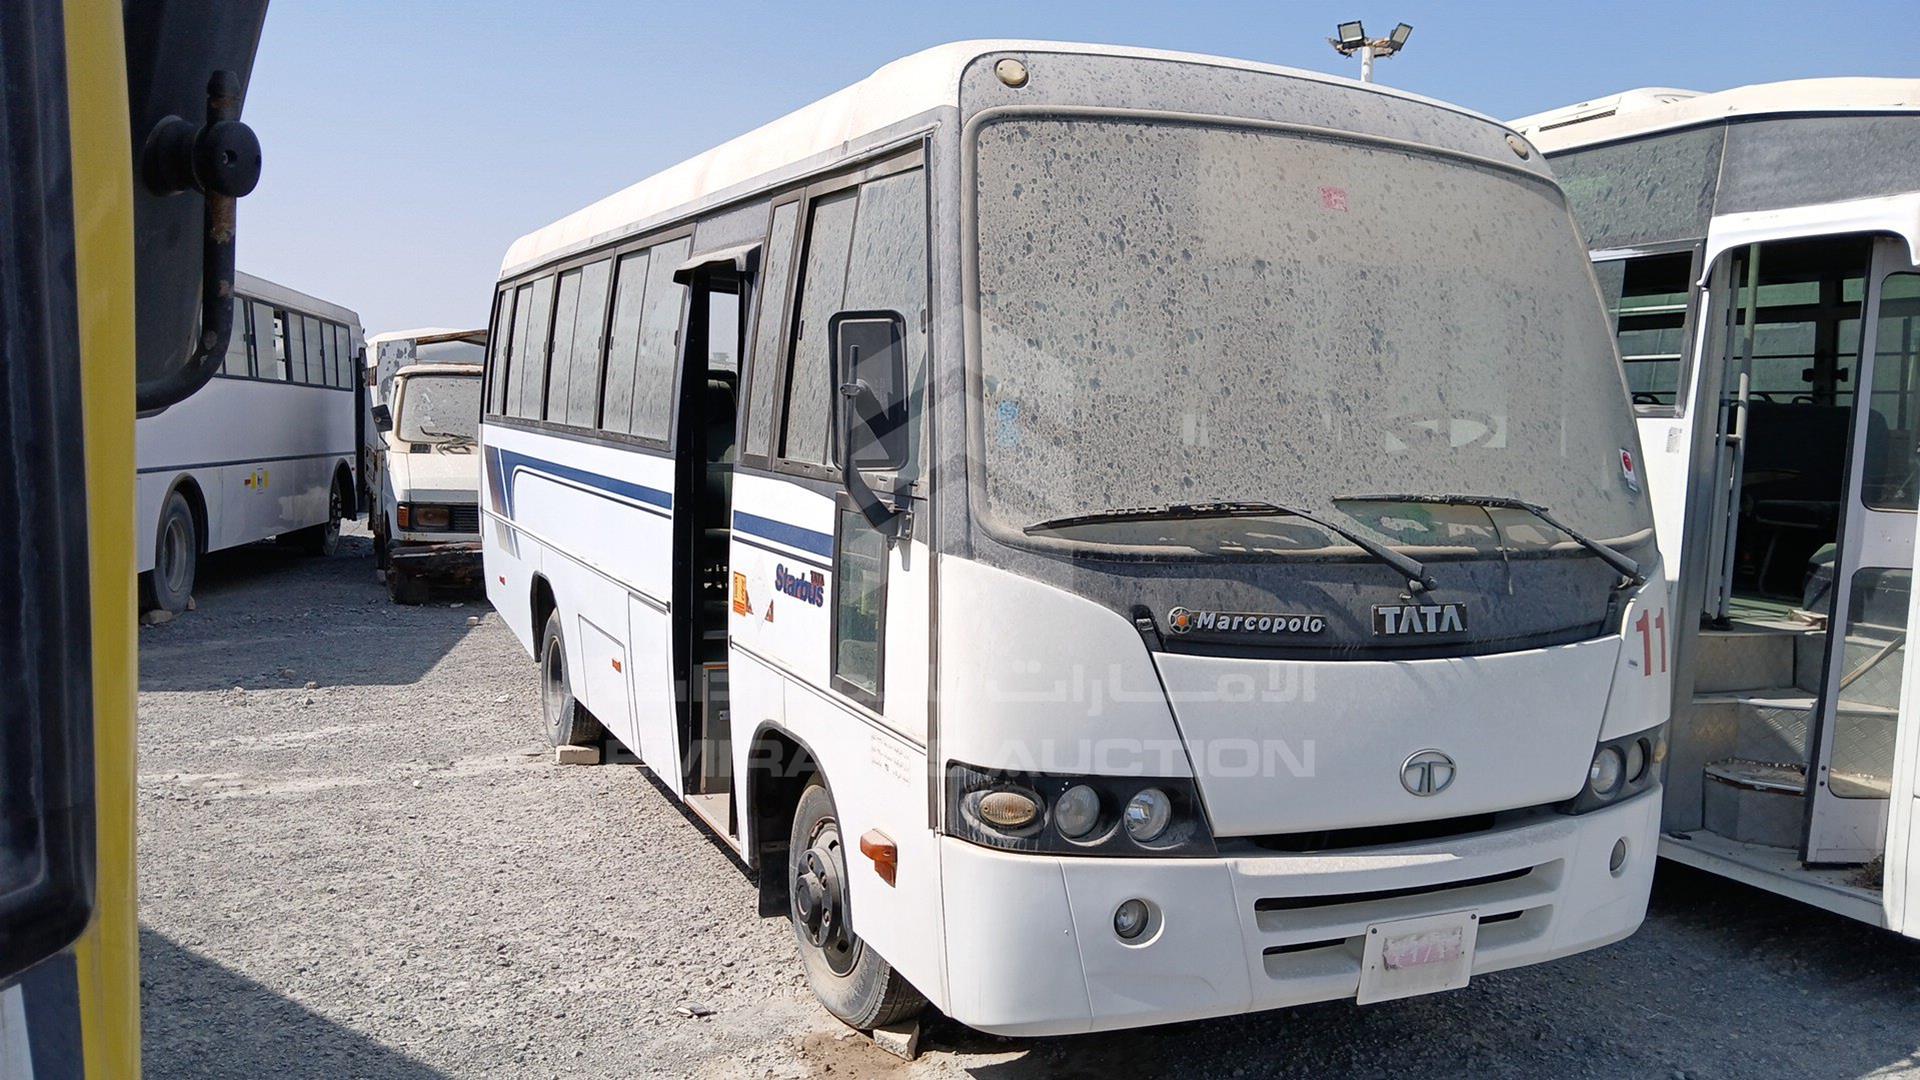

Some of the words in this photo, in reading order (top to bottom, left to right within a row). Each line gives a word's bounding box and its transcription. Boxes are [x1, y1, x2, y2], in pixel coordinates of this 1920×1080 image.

[775, 563, 824, 608] Starbus
[1197, 611, 1323, 633] Marcopolo
[1378, 605, 1463, 634] TATA
[1636, 607, 1667, 677] 11
